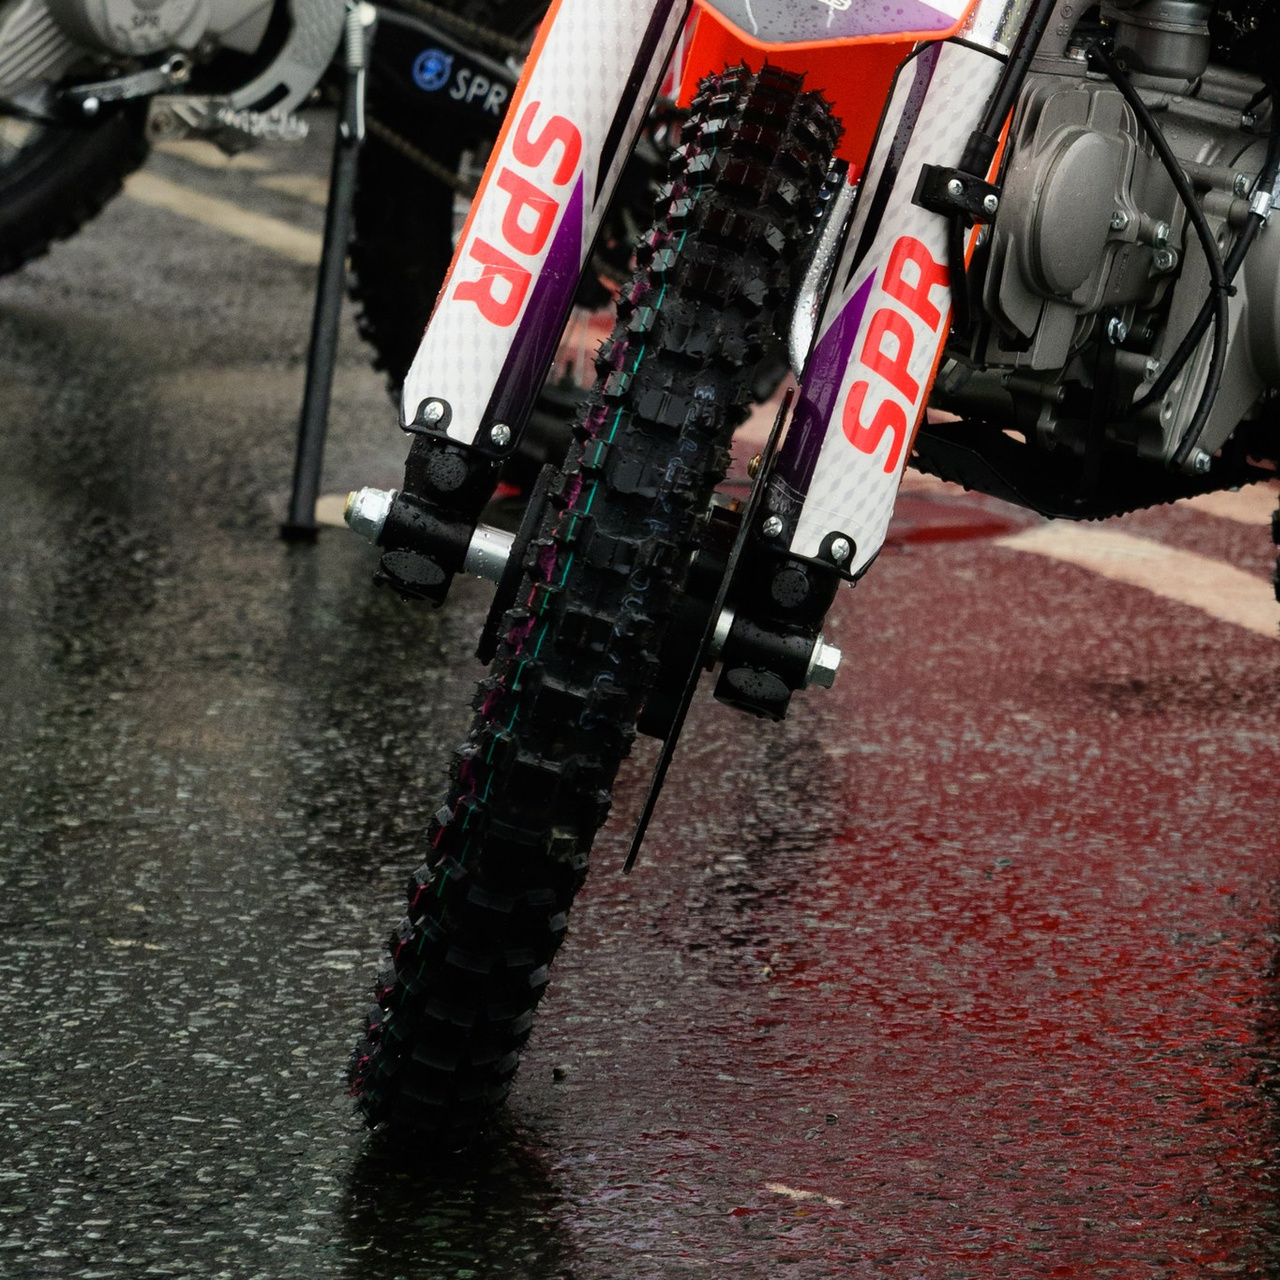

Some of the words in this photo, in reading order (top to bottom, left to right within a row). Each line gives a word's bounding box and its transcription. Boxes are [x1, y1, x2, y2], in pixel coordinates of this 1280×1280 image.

[448, 67, 509, 117] SPR
[454, 100, 583, 328] SPR
[841, 235, 951, 475] SPR
